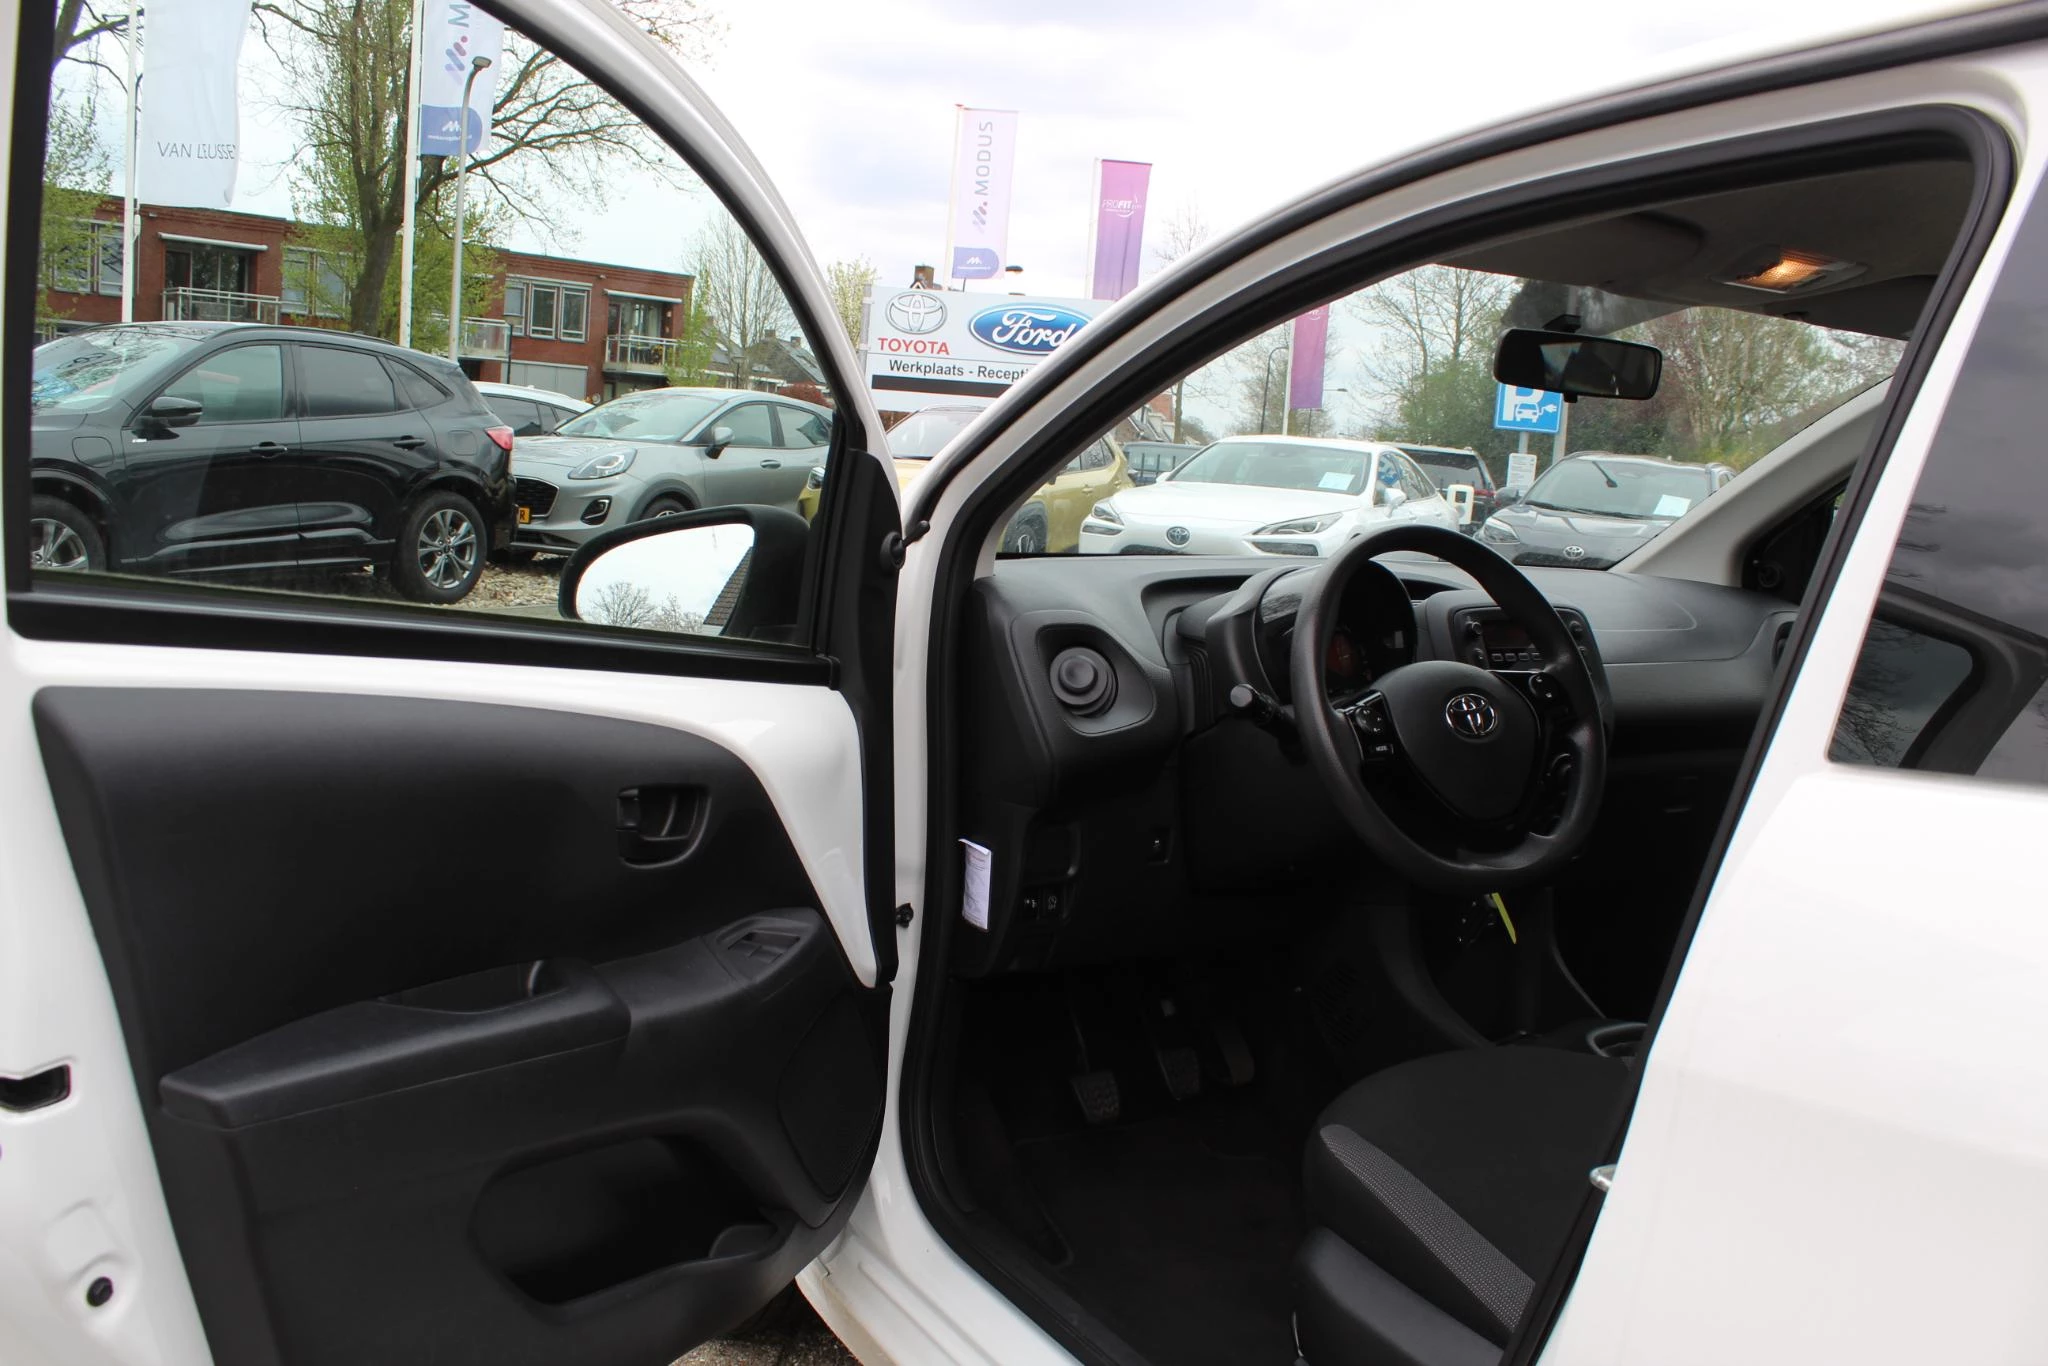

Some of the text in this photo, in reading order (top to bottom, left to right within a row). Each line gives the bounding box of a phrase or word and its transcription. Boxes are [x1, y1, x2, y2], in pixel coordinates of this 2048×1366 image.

[157, 140, 192, 158] VAN
[974, 121, 993, 196] MODUS
[992, 310, 1077, 347] Ford
[878, 337, 950, 355] TOYOTA
[889, 359, 964, 377] Werkplaats
